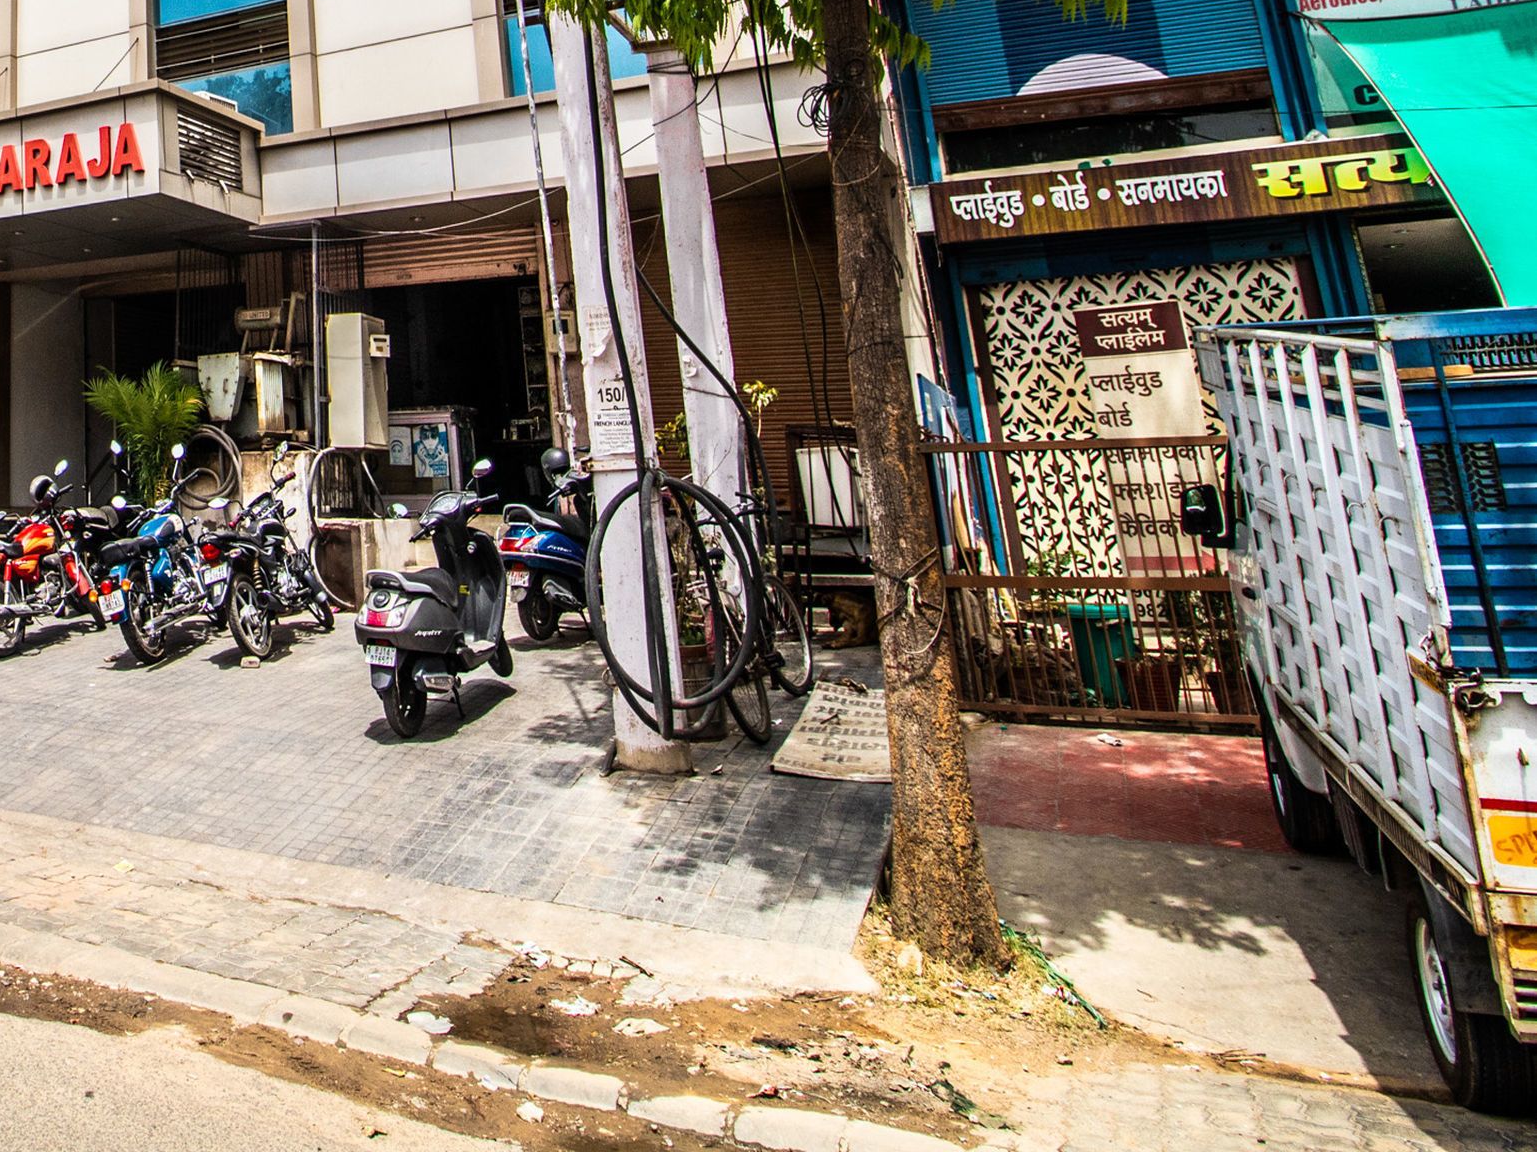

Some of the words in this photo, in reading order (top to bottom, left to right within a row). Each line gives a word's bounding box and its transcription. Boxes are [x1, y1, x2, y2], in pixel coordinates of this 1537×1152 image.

[950, 180, 1025, 228] प्लाईवुड
[1049, 170, 1091, 212] बोर्ड
[1115, 169, 1230, 206] सनमायका
[1097, 308, 1158, 329] सत्यम्
[1094, 326, 1166, 351] प्लाईलेम
[1089, 365, 1164, 397] प्लाईवुड
[1097, 401, 1133, 428] बोर्ड
